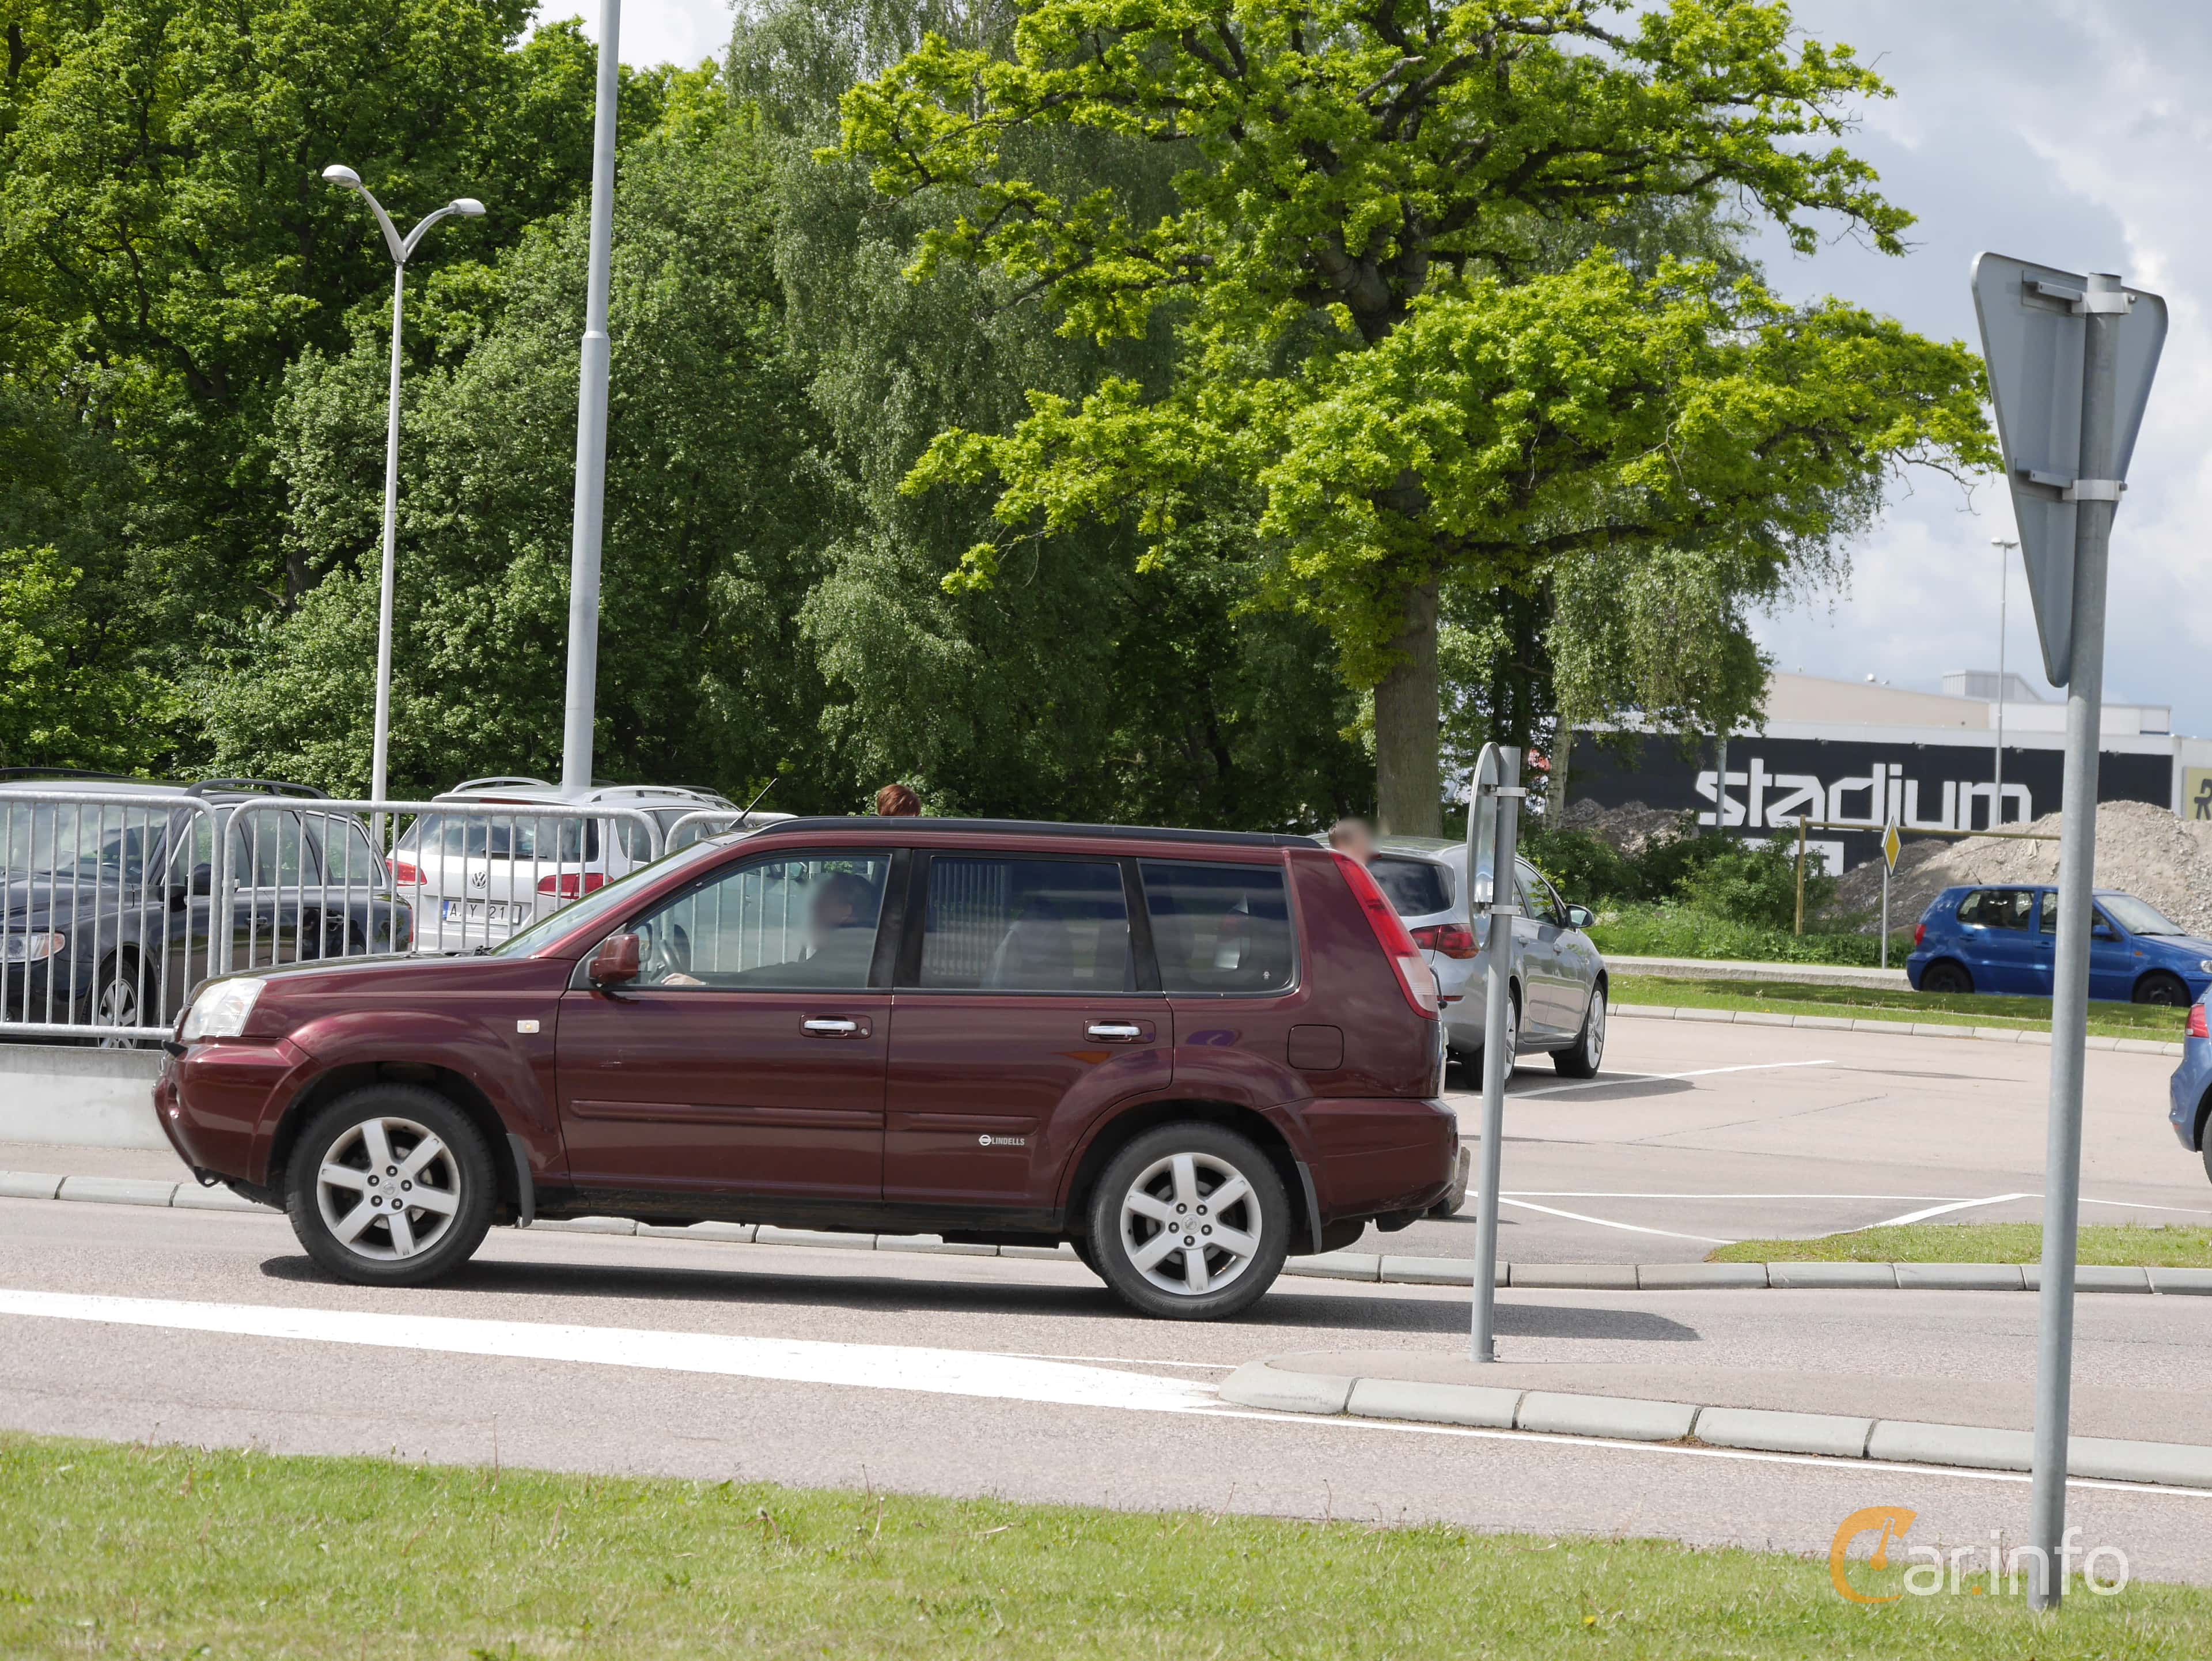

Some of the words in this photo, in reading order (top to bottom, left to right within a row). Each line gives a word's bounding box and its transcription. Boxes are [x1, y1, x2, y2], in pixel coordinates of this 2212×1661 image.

[1695, 758, 2033, 831] stadium
[449, 903, 478, 918] AY
[489, 906, 515, 920] 21
[991, 1137, 1025, 1146] LINDELLS
